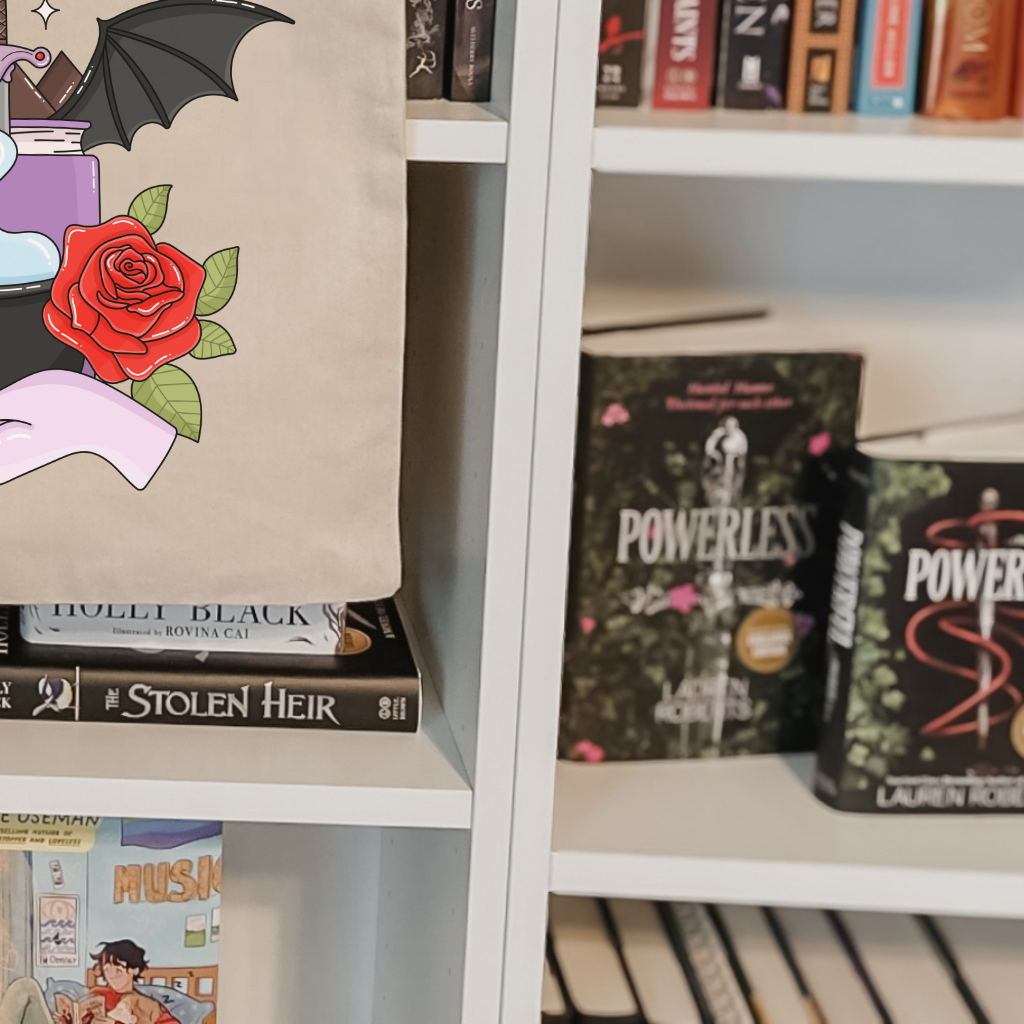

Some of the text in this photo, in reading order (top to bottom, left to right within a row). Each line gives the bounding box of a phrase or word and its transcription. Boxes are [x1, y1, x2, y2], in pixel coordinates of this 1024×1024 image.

[616, 504, 818, 565] POWERLESS
[166, 625, 219, 638] ROVINA
[223, 628, 249, 639] CAI
[105, 681, 341, 726] THE STOLEN HEIR
